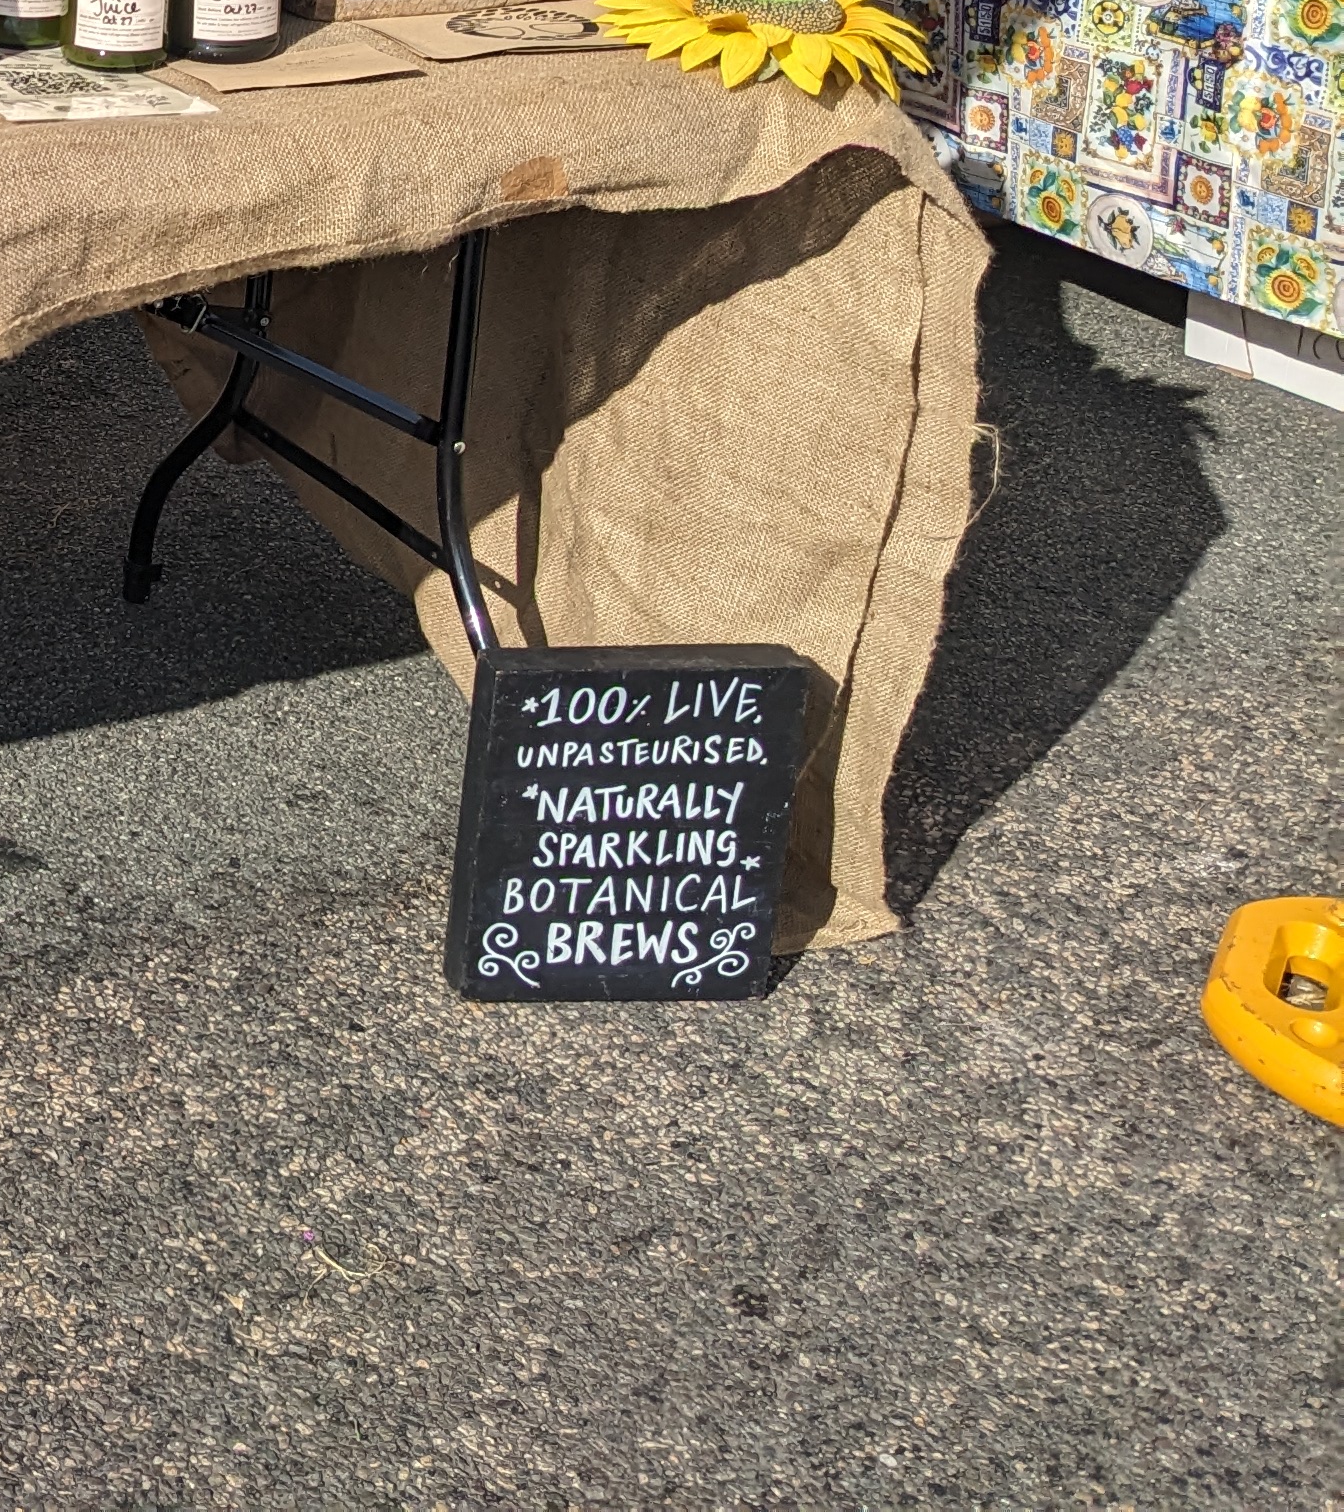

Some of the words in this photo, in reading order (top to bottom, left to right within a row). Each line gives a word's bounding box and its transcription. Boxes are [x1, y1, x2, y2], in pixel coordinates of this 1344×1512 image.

[102, 16, 117, 25] Oct
[121, 17, 132, 26] 27
[246, 4, 257, 14] 27
[537, 782, 744, 824] NATURALLY
[532, 829, 737, 869] SPARKLING
[503, 873, 756, 916] BOTANICAL
[546, 920, 699, 966] BREWS
